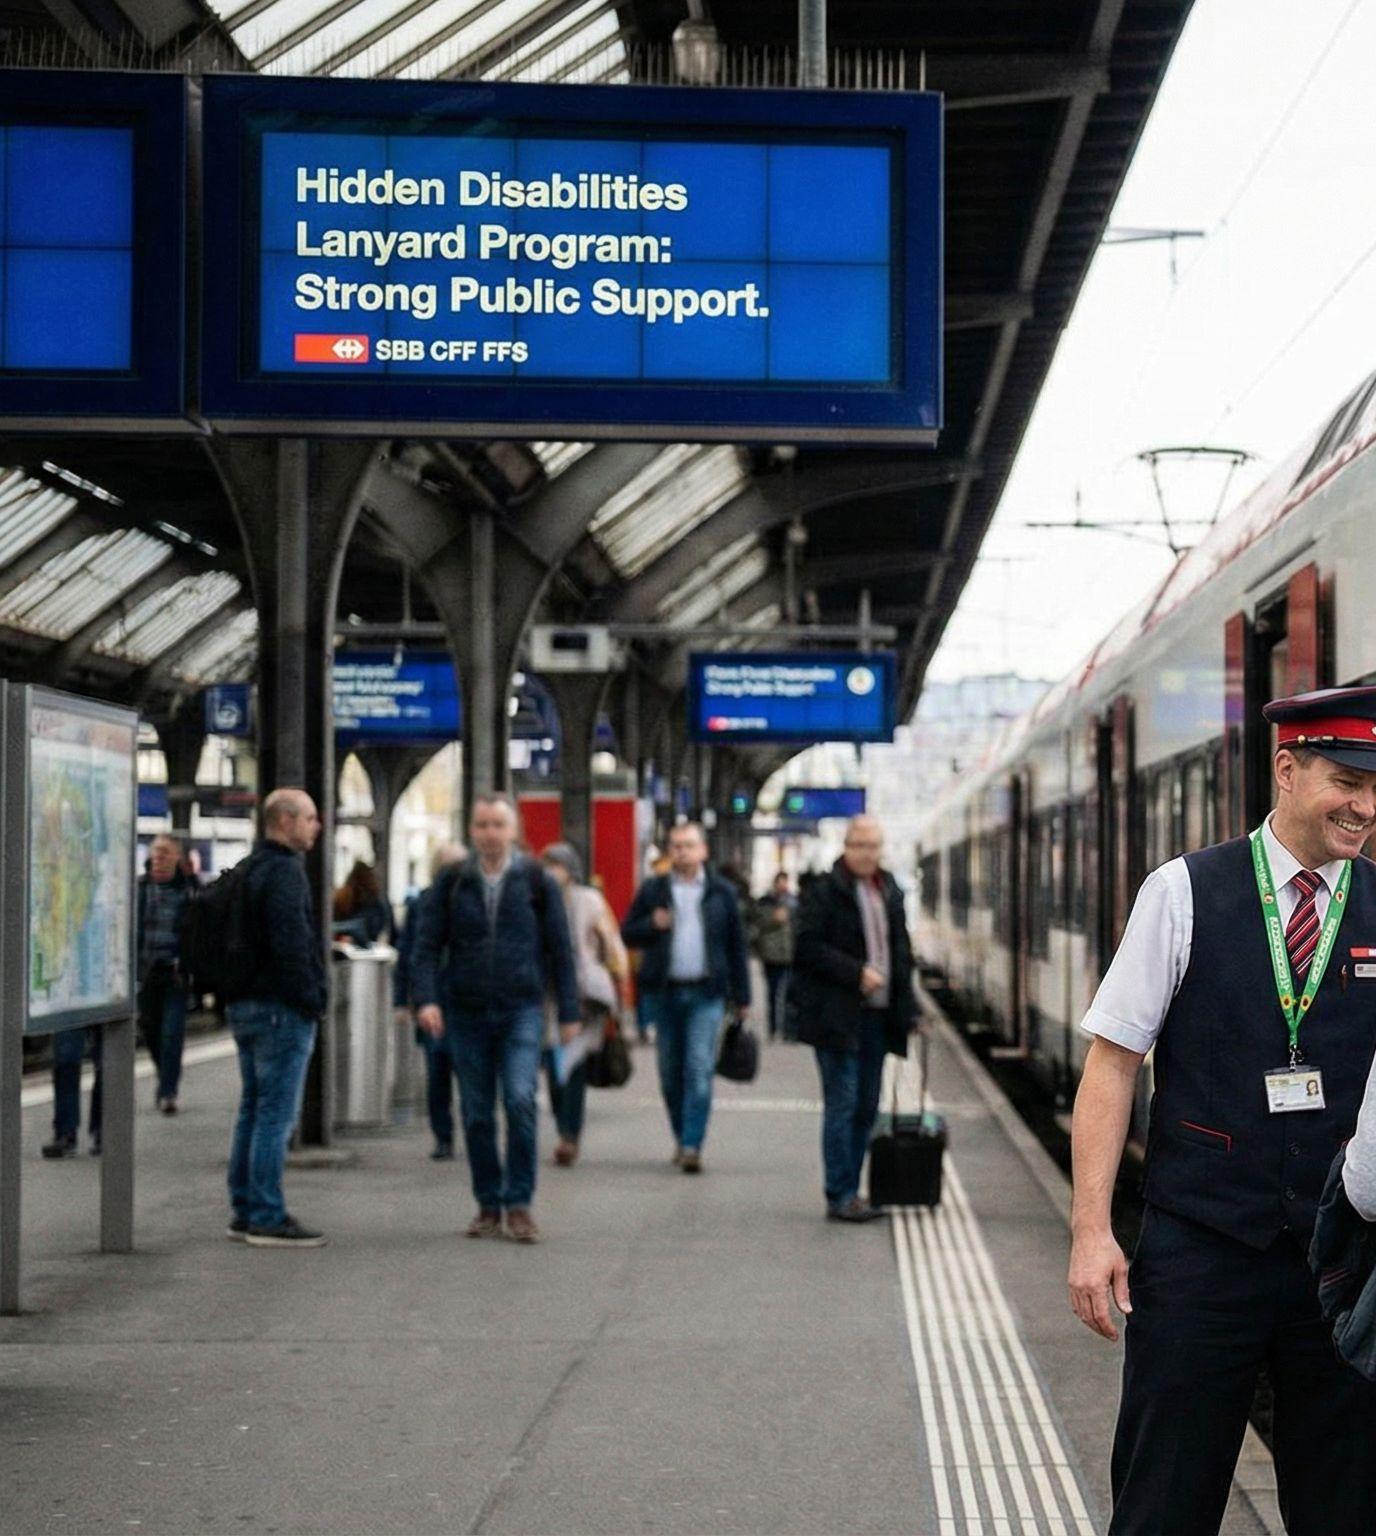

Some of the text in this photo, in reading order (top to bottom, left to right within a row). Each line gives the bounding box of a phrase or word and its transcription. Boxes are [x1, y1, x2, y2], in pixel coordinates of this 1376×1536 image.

[296, 167, 688, 212] Hidden Disabilities
[296, 221, 672, 269] Lanyard Program:
[294, 273, 770, 324] Strong Public Support.
[375, 338, 529, 363] SBB CFF FFS
